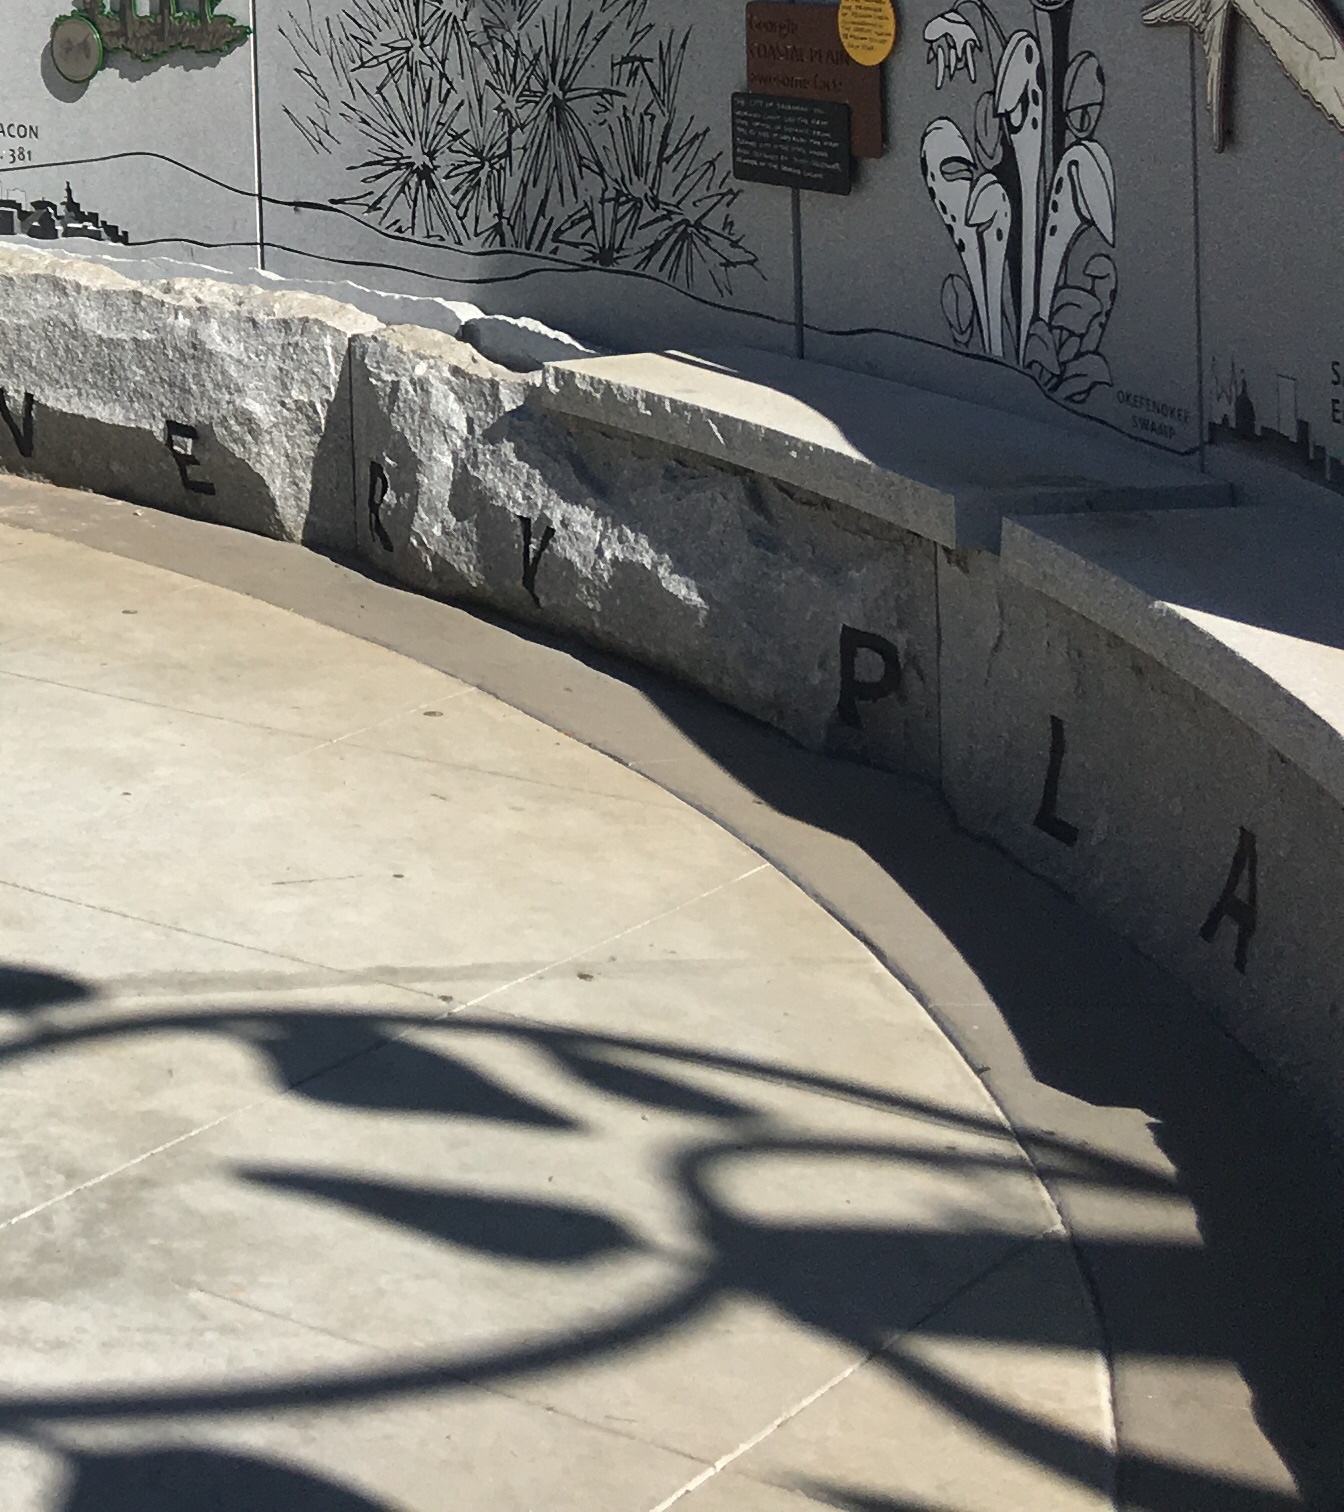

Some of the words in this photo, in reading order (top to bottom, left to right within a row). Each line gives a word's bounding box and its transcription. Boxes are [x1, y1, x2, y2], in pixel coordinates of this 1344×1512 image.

[7, 145, 33, 164] 381
[1116, 389, 1191, 424] OKEFENOKEE
[1131, 414, 1176, 439] SWAMP
